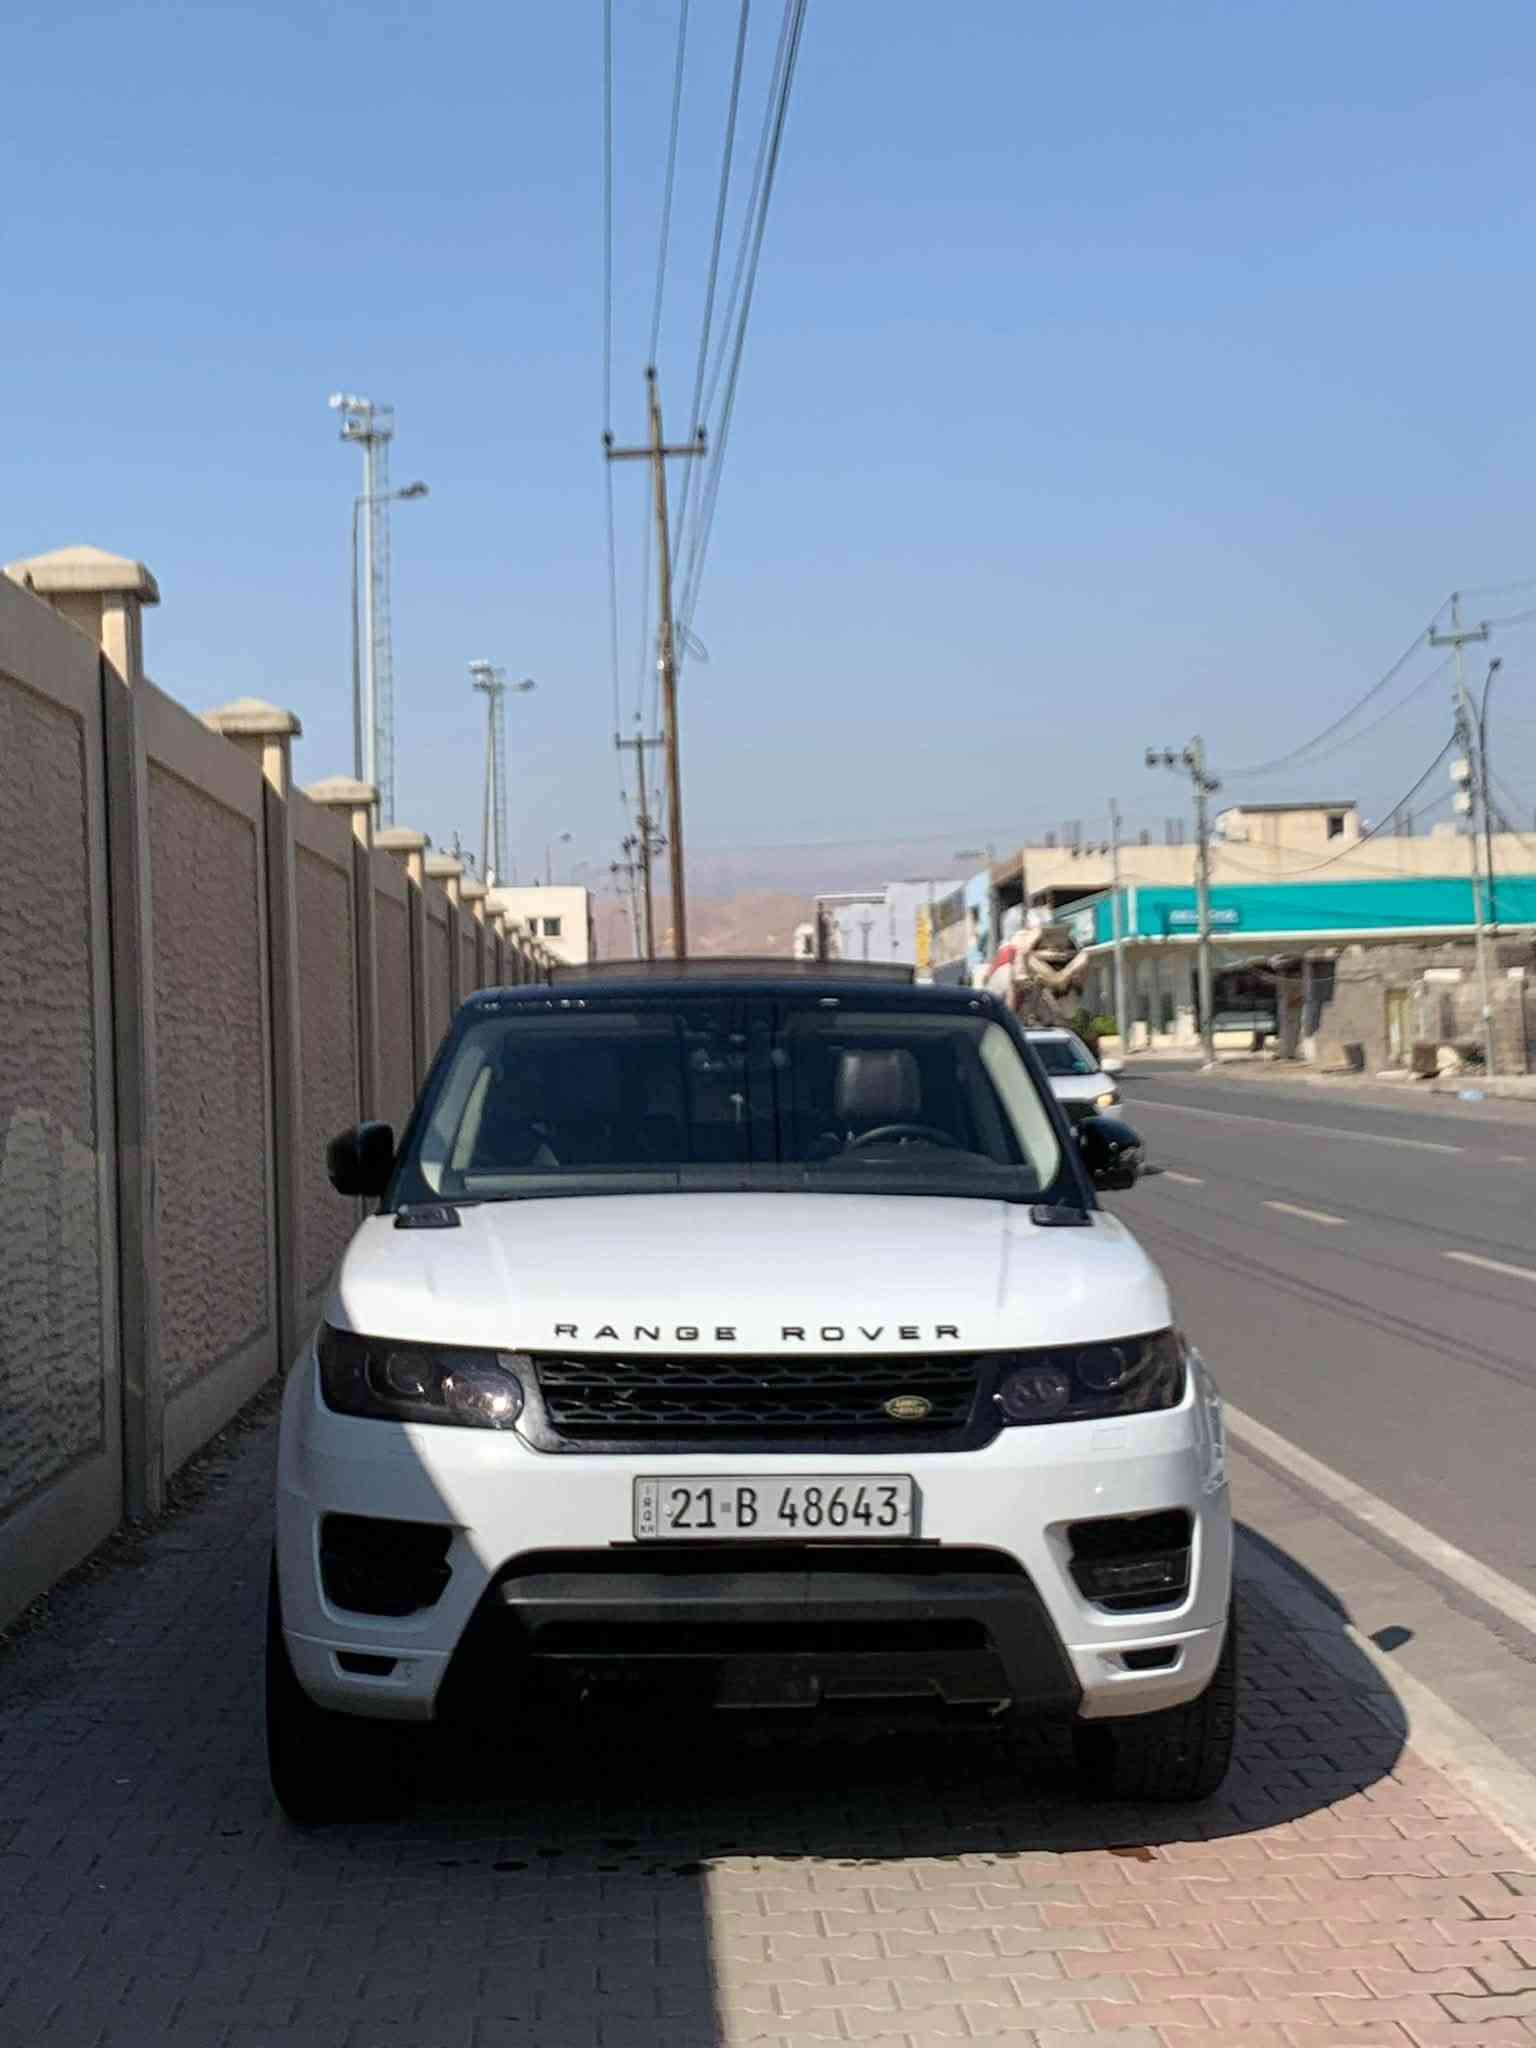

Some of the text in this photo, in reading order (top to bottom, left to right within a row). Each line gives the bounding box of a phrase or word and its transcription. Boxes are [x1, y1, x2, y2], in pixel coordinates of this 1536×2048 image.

[555, 1324, 960, 1341] RANGE ROVER
[777, 1486, 898, 1527] 48643
